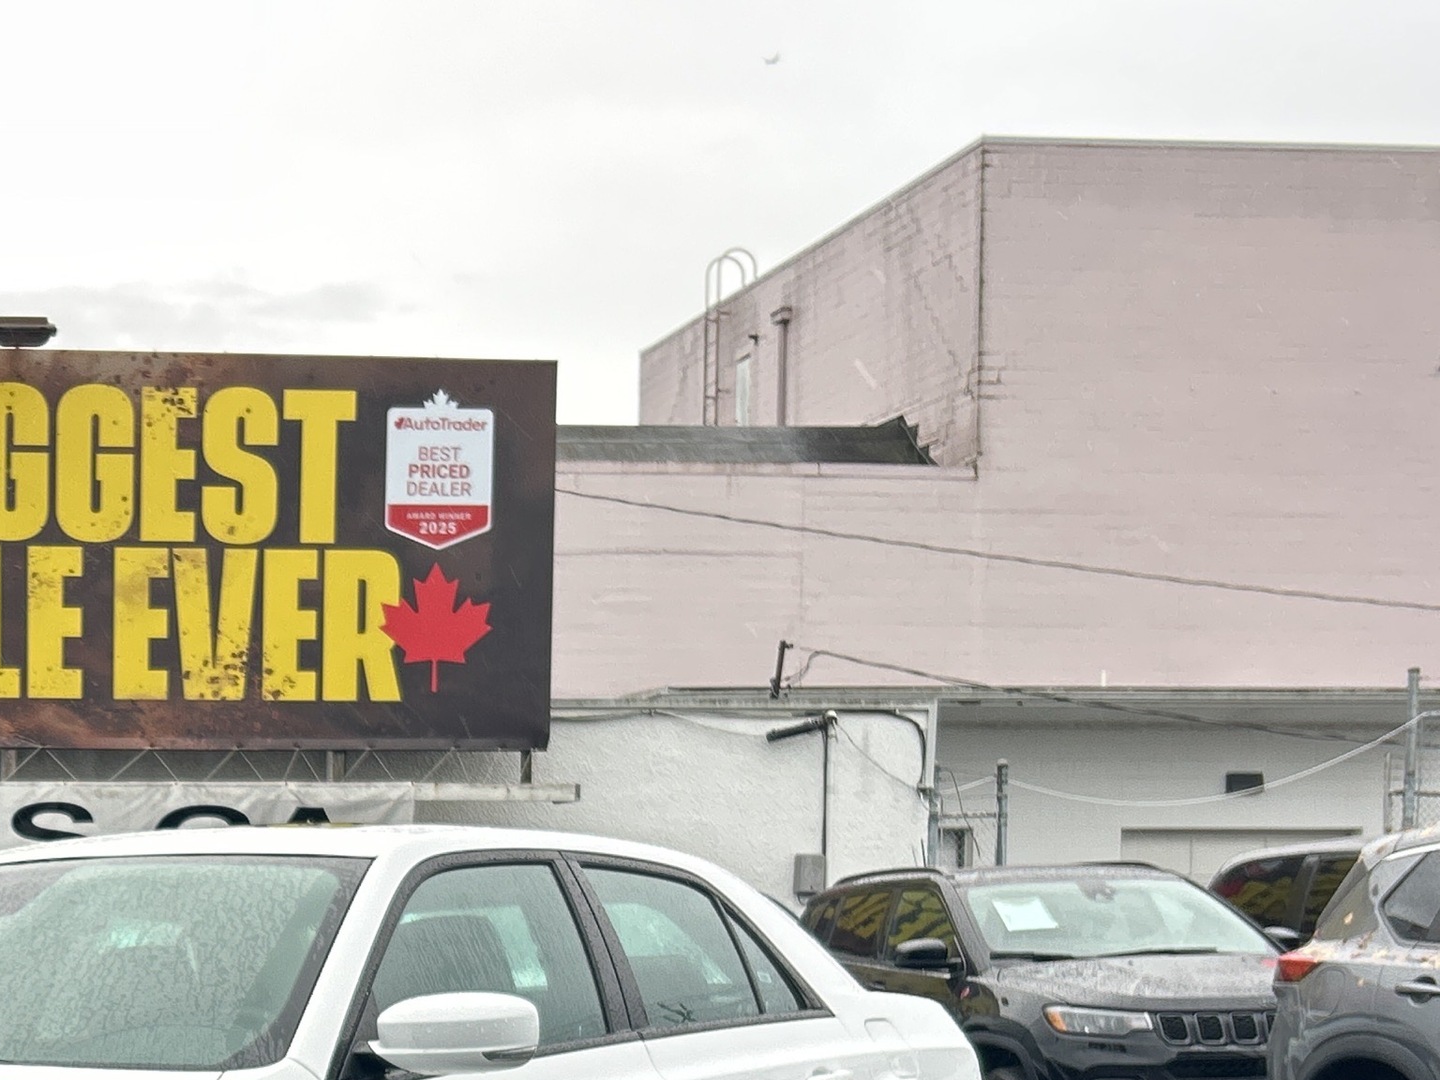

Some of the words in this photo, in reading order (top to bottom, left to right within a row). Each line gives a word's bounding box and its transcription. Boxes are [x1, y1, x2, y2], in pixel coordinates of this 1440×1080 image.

[403, 417, 488, 432] AutoTrader
[418, 446, 462, 462] BEST
[408, 463, 471, 480] PRICED
[406, 480, 472, 497] DEALER
[406, 512, 436, 520] AWARD
[438, 513, 473, 521] WINNER
[418, 521, 458, 535] 2025
[112, 547, 403, 704] EVER
